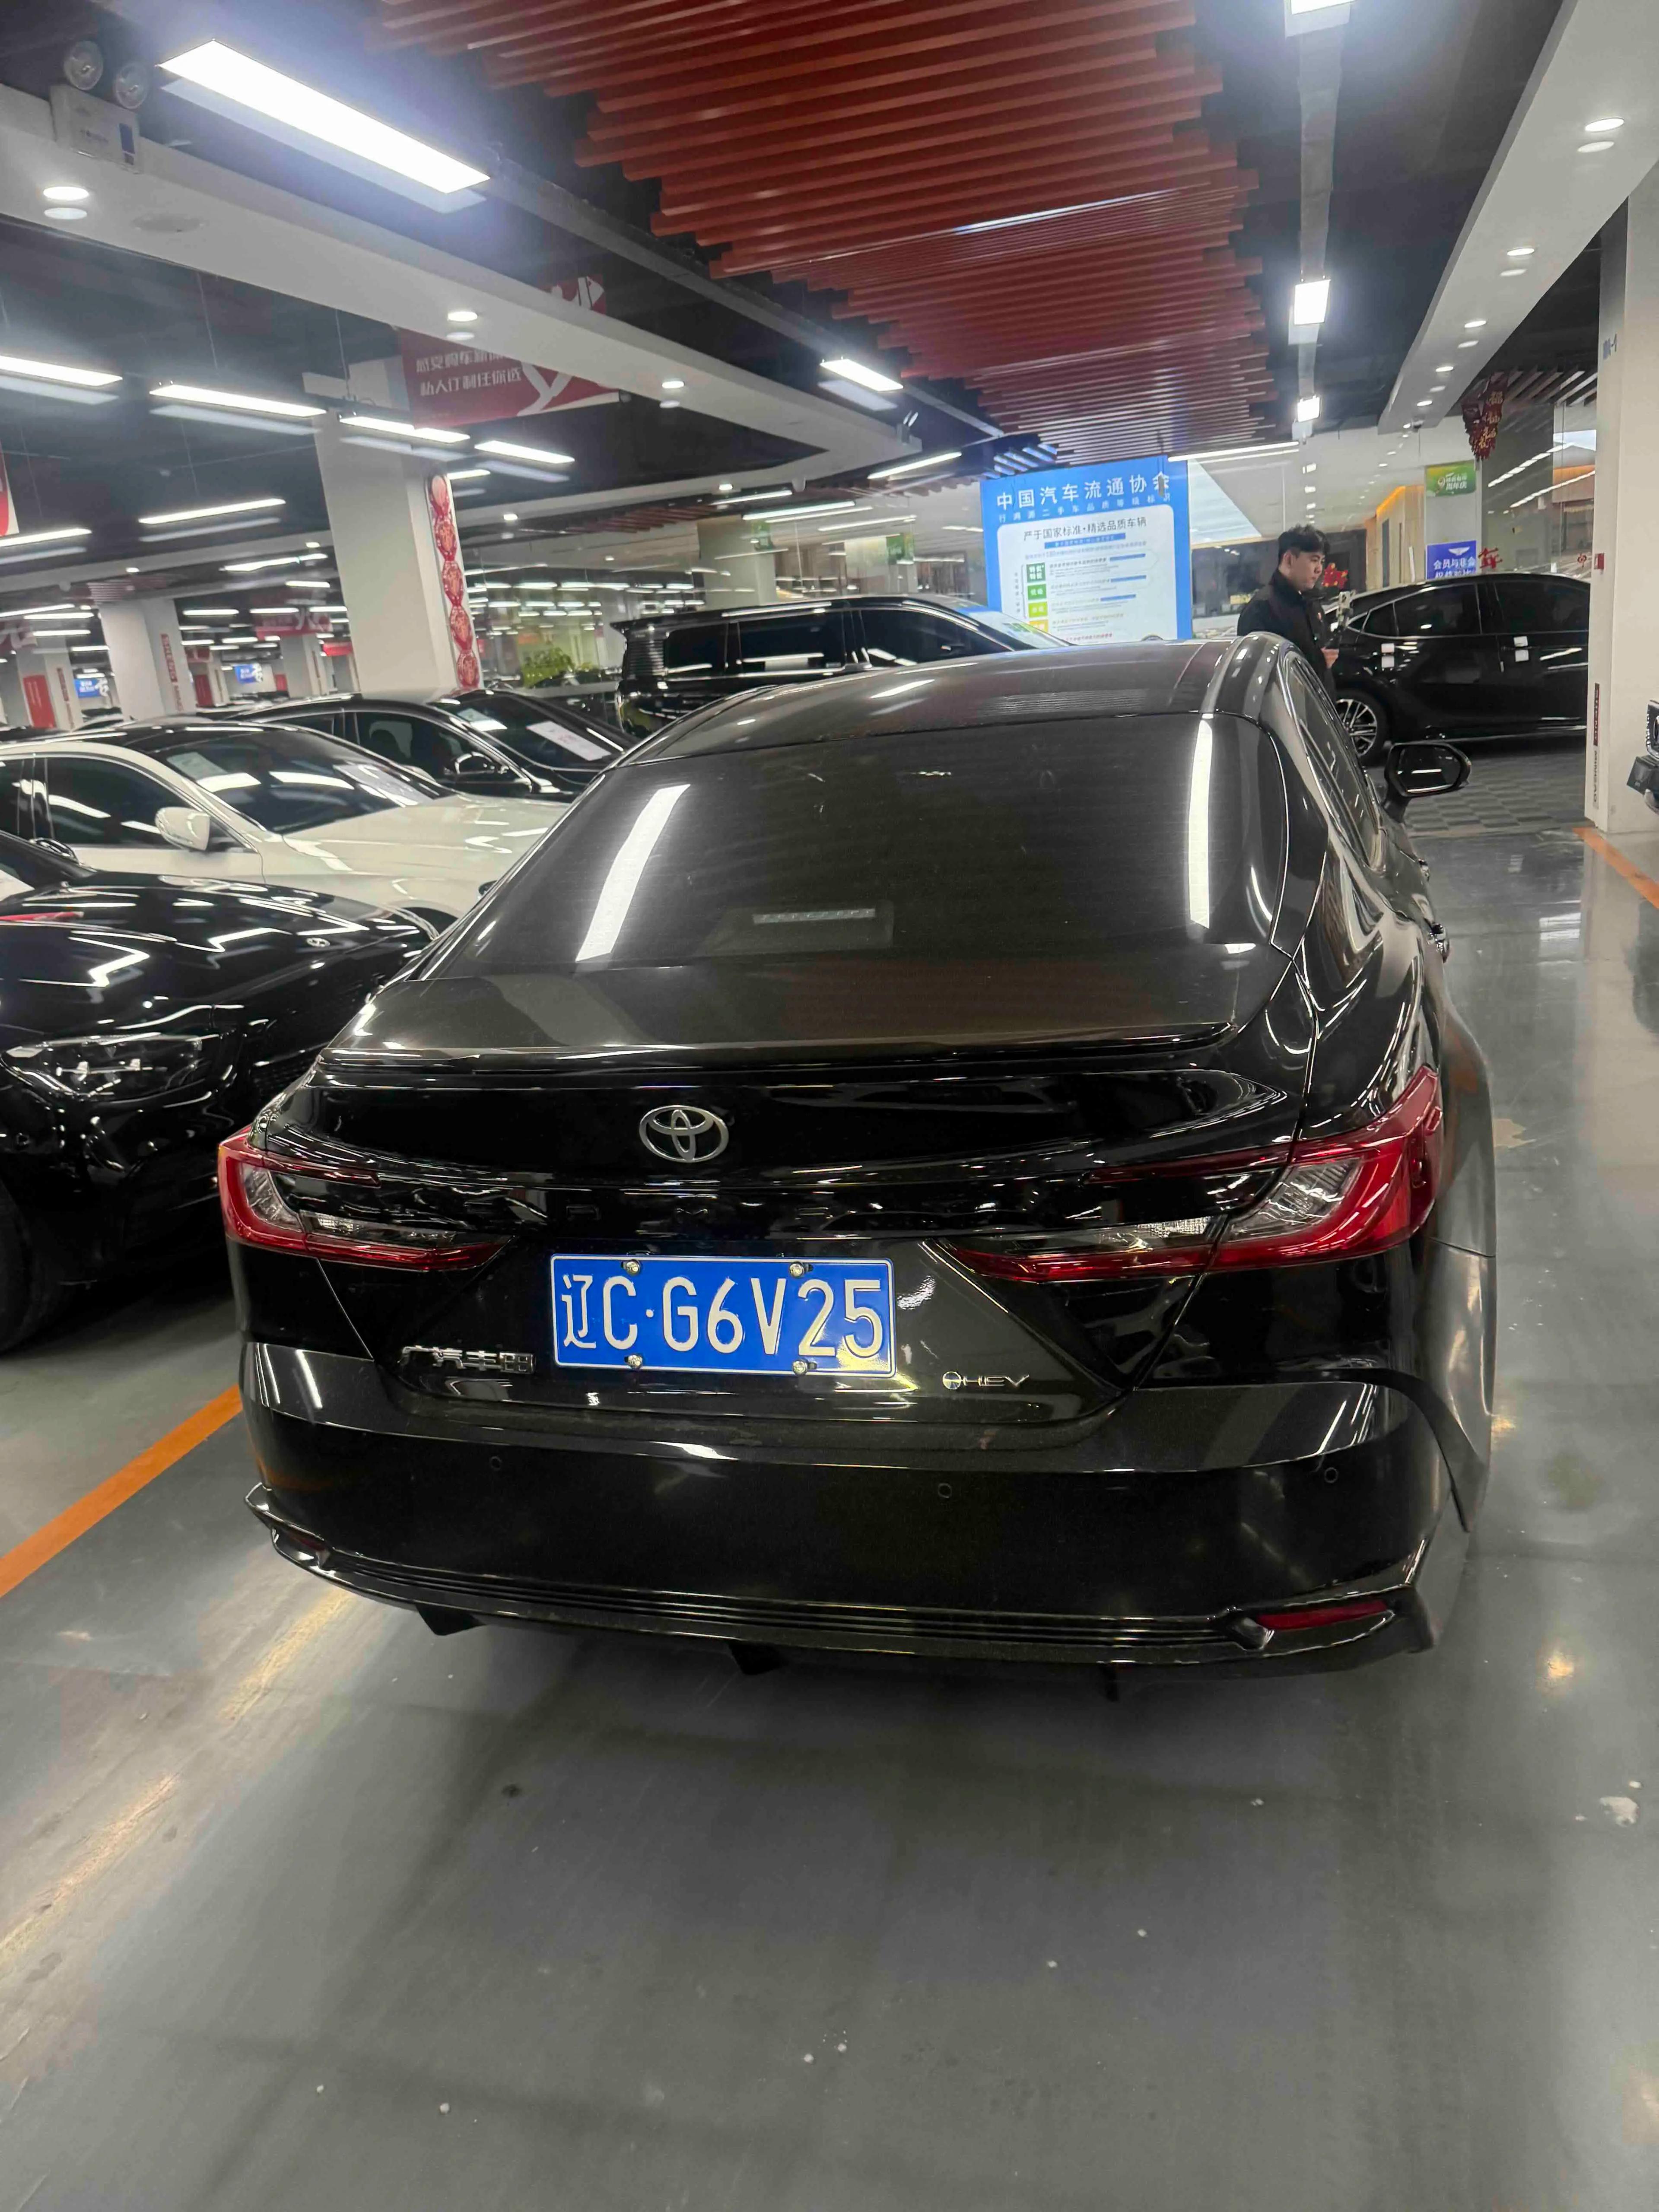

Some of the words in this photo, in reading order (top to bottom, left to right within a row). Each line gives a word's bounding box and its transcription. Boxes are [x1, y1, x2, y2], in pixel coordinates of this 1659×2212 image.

[997, 471, 1170, 511] 中国汽车流通协会
[561, 1274, 884, 1358] 辽C·G6V25
[397, 1345, 536, 1375] 广汽丰田
[963, 1374, 1030, 1387] HEV
